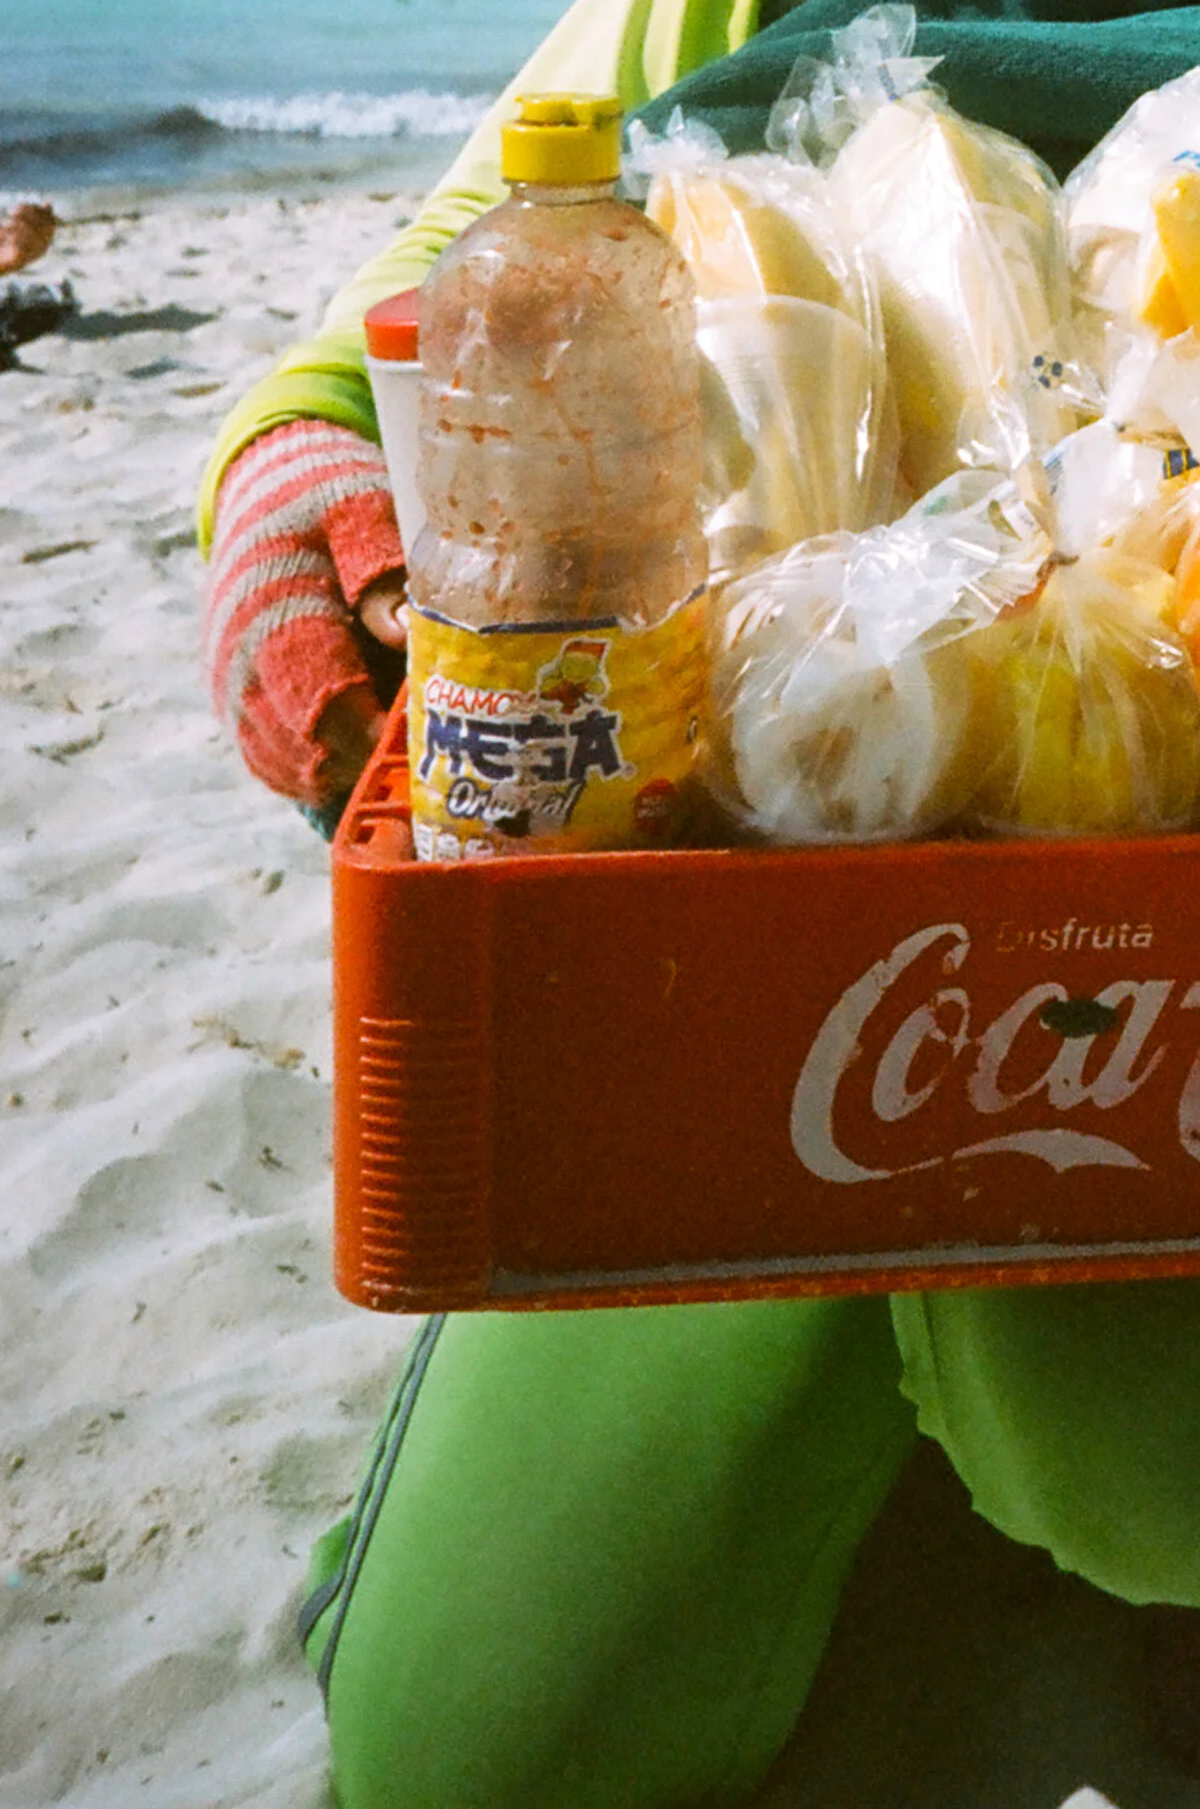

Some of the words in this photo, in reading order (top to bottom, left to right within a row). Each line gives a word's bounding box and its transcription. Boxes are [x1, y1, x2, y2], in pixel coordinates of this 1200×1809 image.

[426, 679, 536, 715] CHAMO
[420, 708, 621, 781] MEGA
[448, 778, 584, 822] Orinal
